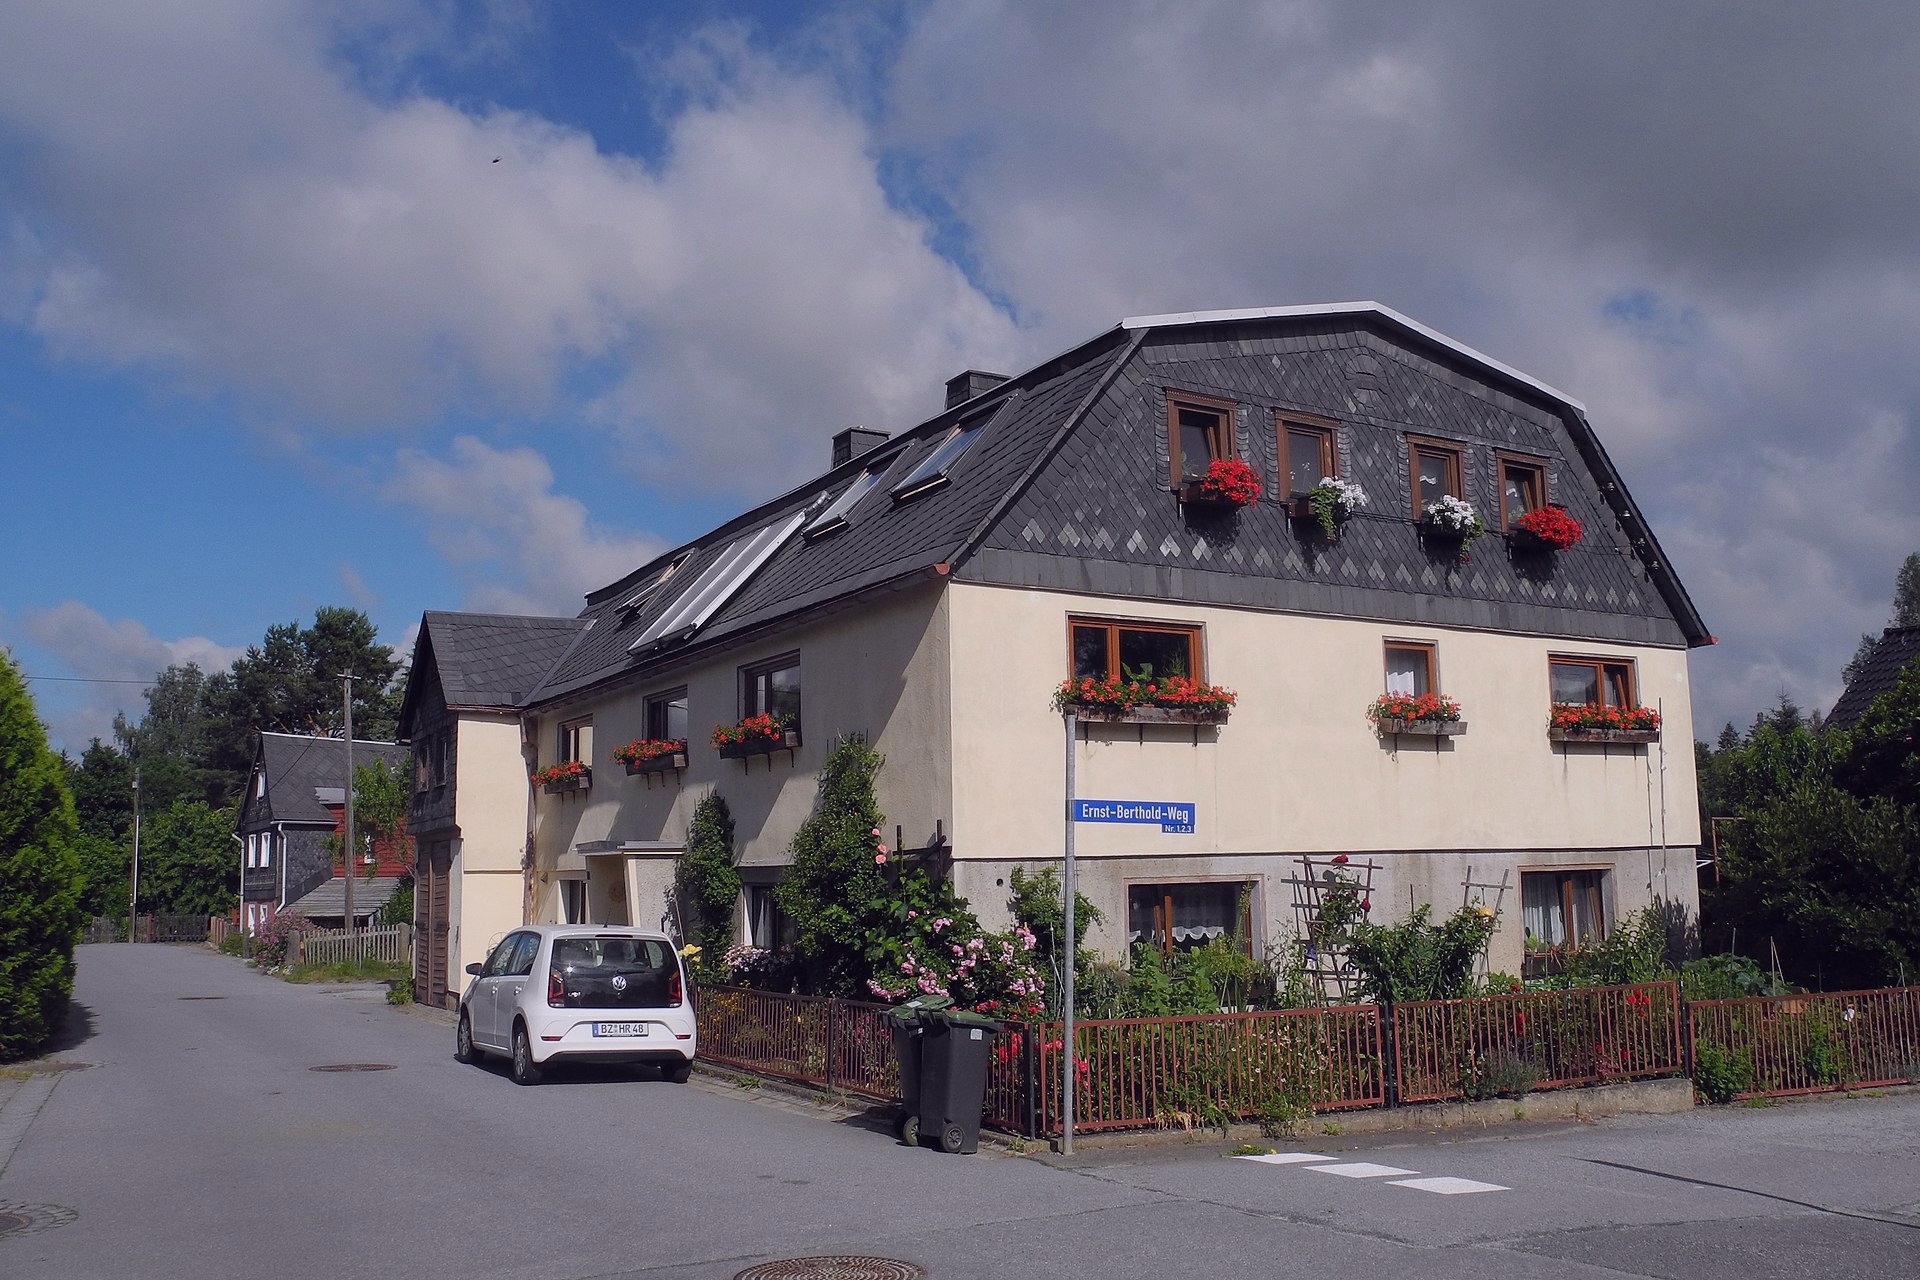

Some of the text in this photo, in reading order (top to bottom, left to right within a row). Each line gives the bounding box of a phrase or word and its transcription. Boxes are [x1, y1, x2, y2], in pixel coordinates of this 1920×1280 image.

[1082, 803, 1189, 824] Ernst-Berthold-Weg
[601, 1024, 644, 1033] BZ HR 48
